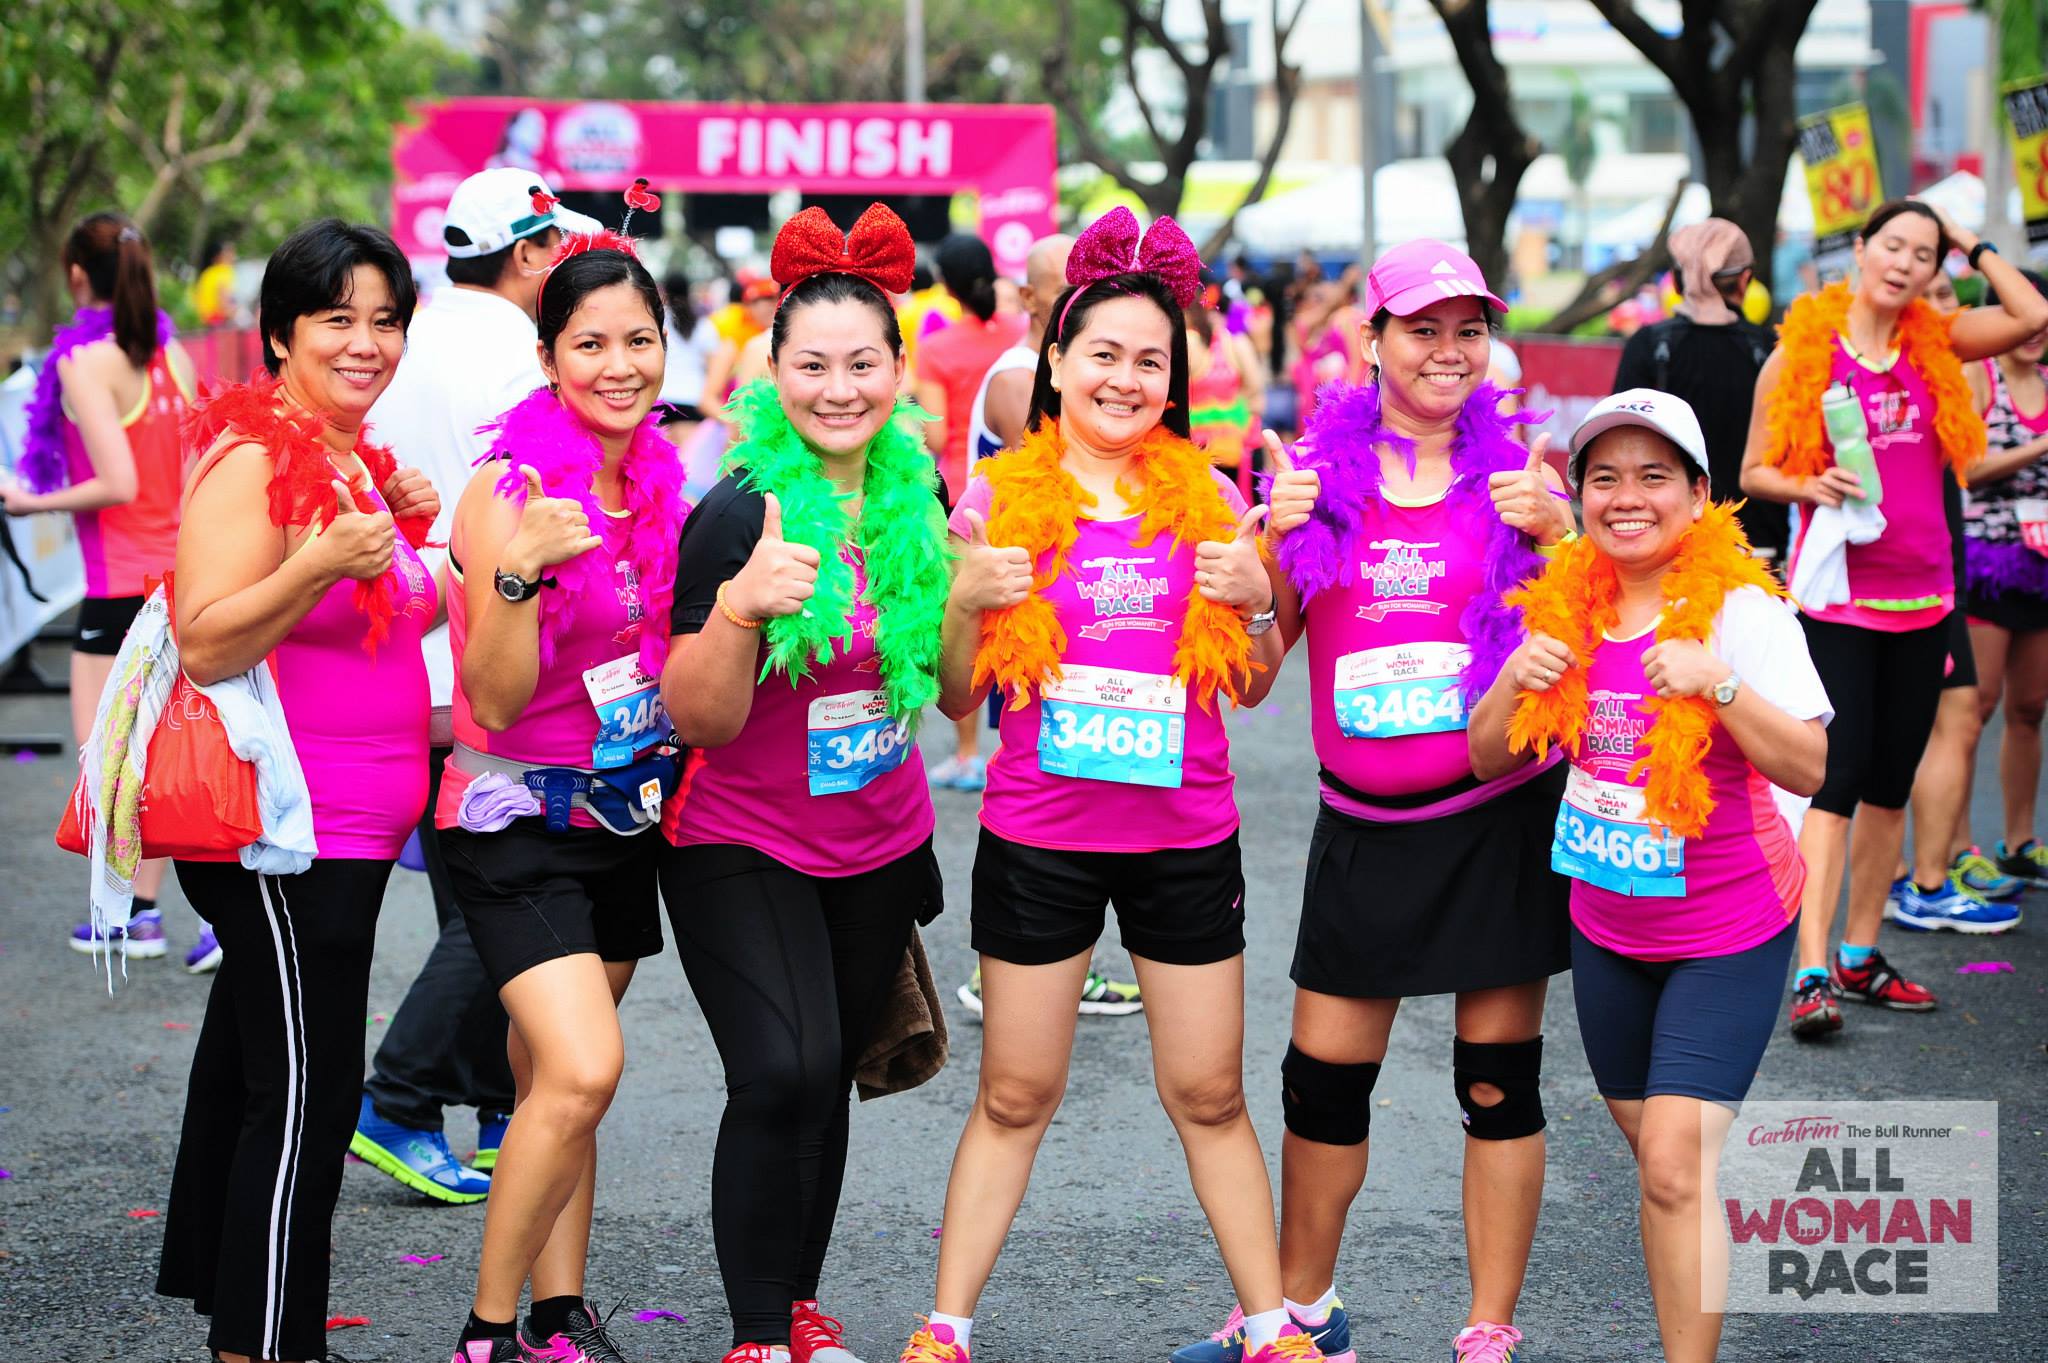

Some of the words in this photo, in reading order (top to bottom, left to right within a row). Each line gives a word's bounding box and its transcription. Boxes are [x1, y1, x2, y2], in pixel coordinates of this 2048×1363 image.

[698, 117, 952, 177] FINISH
[1386, 548, 1423, 563] ALL
[1102, 564, 1142, 582] ALL
[1361, 561, 1445, 579] WOMAN
[1076, 577, 1168, 599] WOMAN
[1373, 578, 1429, 598] RACE
[1094, 595, 1153, 617] RACE
[1386, 659, 1425, 669] WOMAN
[1397, 652, 1413, 660] ALL
[1393, 667, 1419, 677] RACE
[1095, 684, 1133, 695] WOMAN
[1106, 677, 1124, 686] ALL
[1100, 693, 1127, 703] RACE
[610, 694, 665, 742] 346
[868, 707, 887, 716] RAC
[1351, 686, 1464, 732] 3464
[1593, 700, 1627, 718] ALL
[1052, 709, 1163, 759] 3468
[1588, 735, 1634, 755] RACE
[810, 752, 821, 765] 5K
[1601, 791, 1617, 799] ALL
[1597, 805, 1621, 816] RACE
[1565, 815, 1662, 872] 3466
